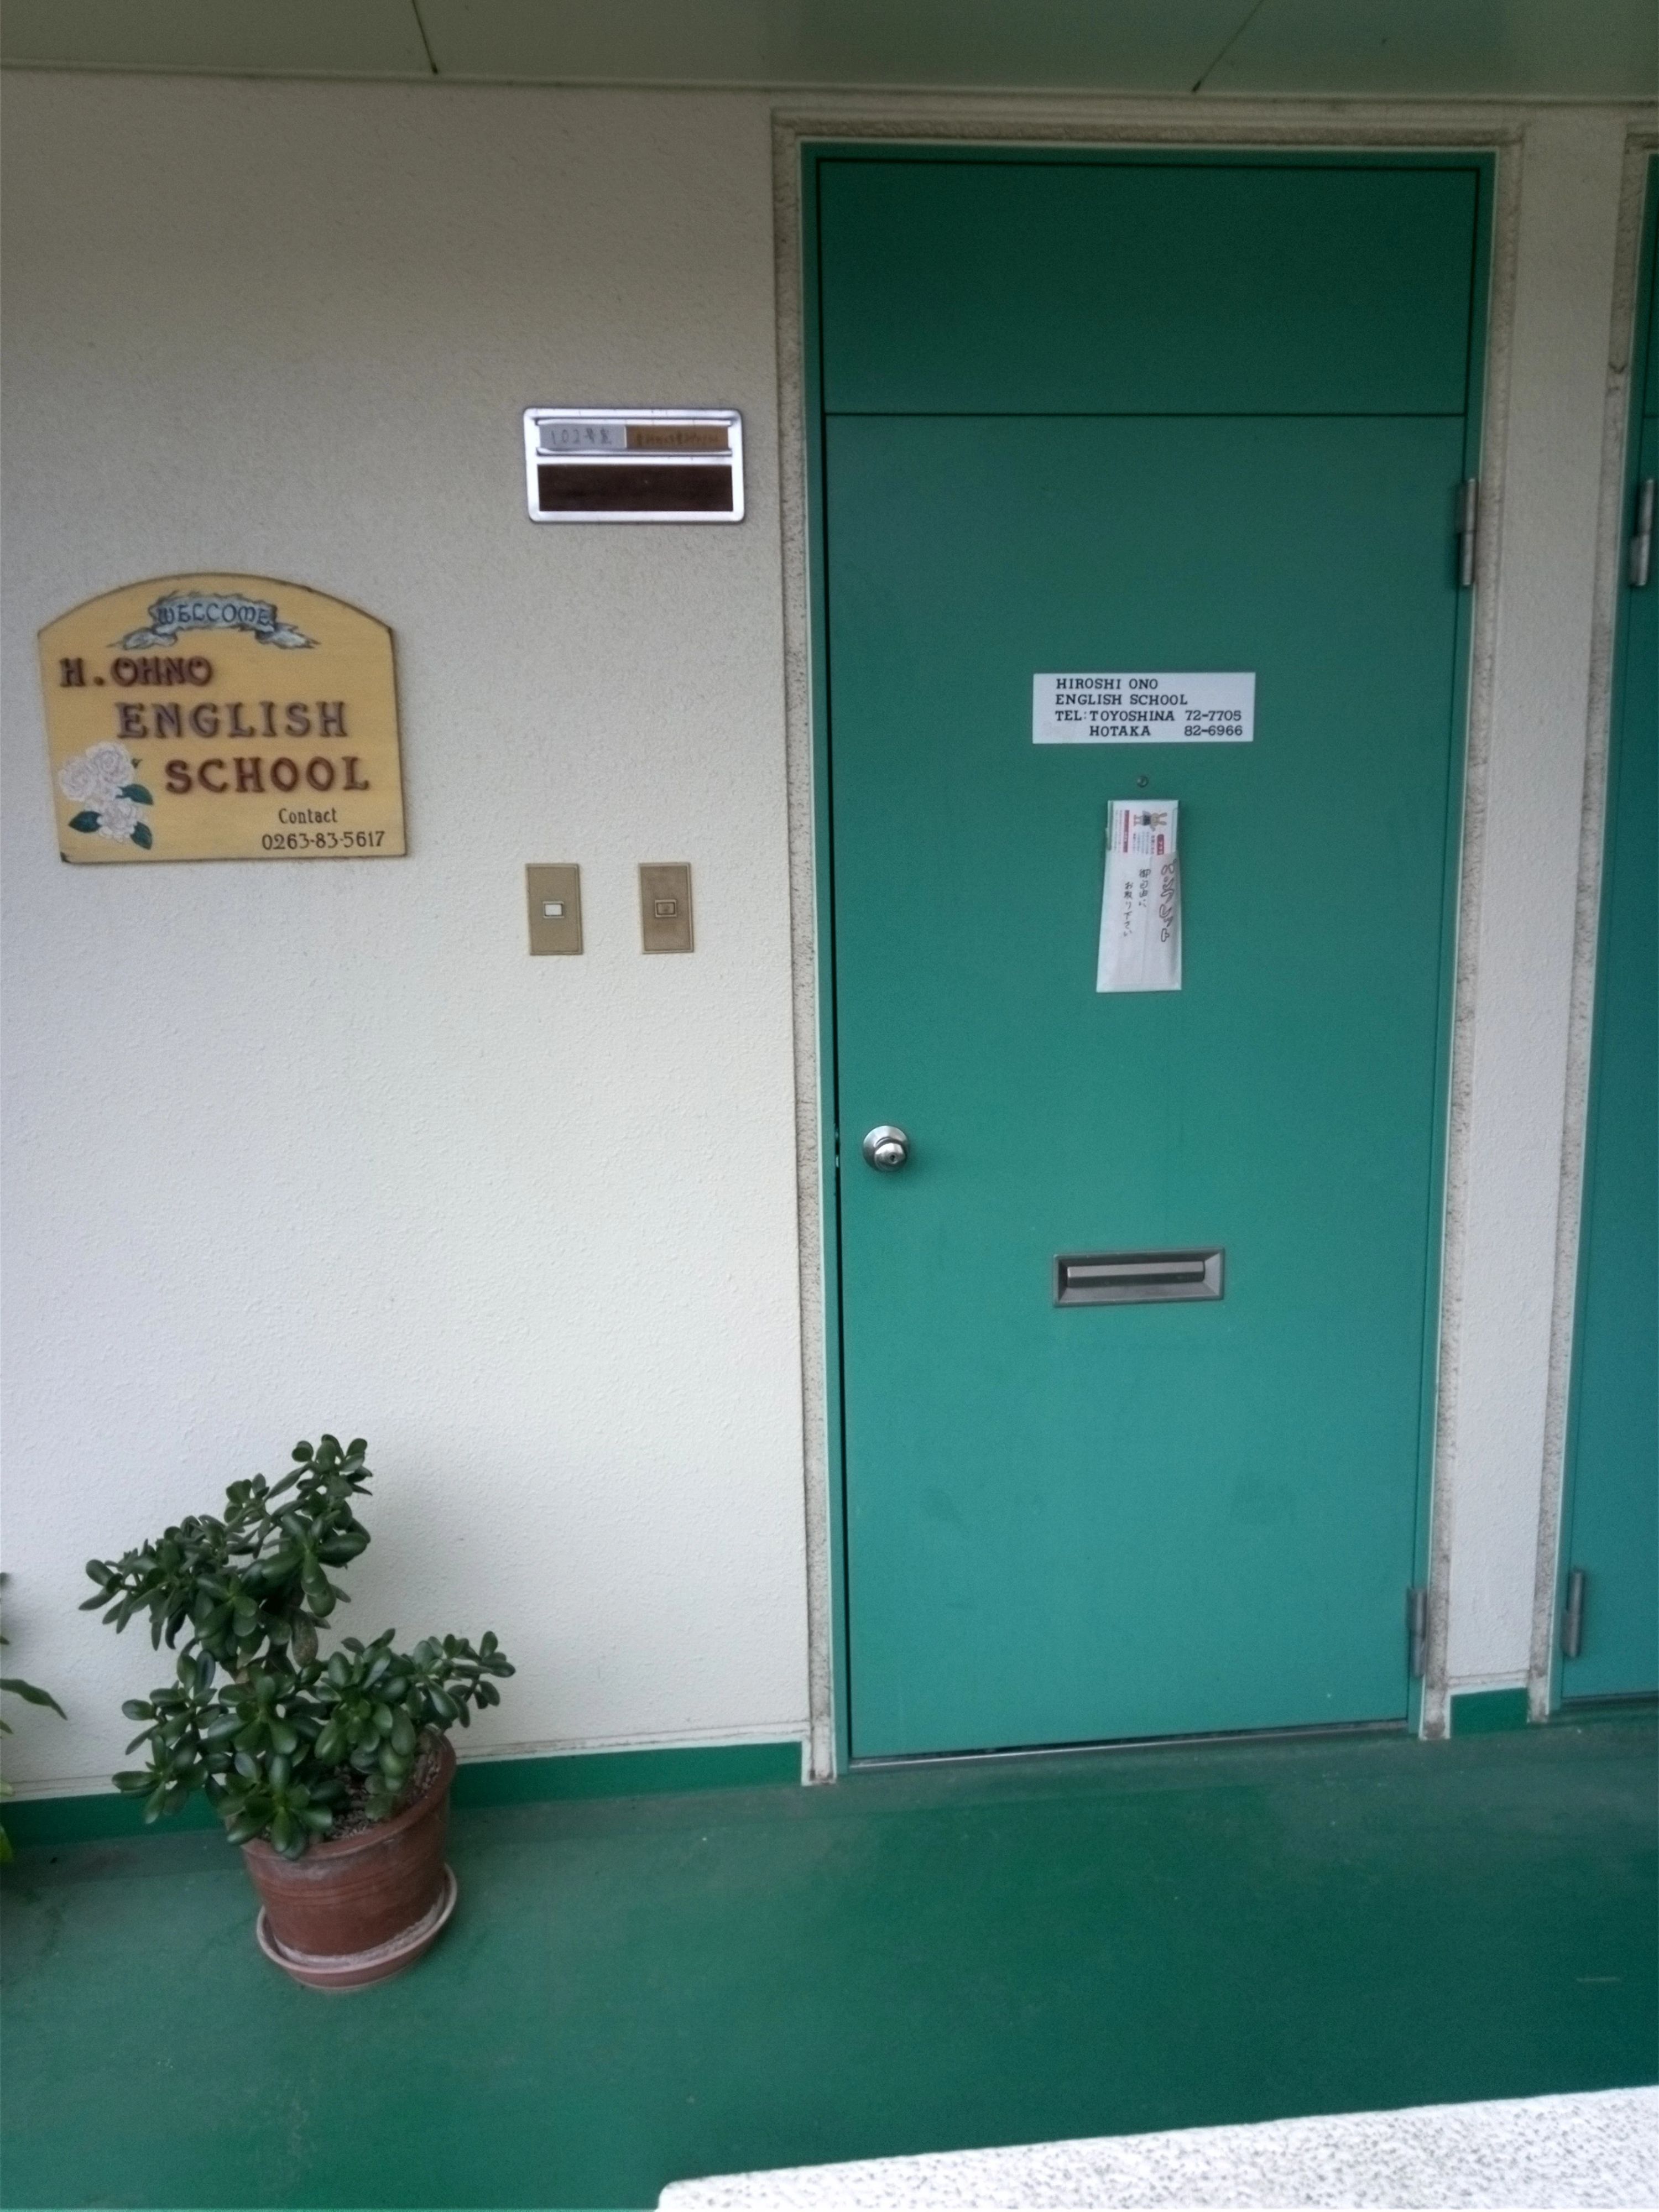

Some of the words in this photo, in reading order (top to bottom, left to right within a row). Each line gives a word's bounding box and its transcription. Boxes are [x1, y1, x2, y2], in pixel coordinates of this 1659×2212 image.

[158, 602, 271, 625] WELCOME
[1056, 678, 1121, 690] HIROSHI
[1129, 678, 1159, 690] ONO
[1055, 694, 1122, 705] ENGLISH
[1130, 694, 1188, 706] SCHOOL
[116, 701, 348, 739] ENGLISH
[1185, 710, 1242, 721] 72-7705
[1089, 726, 1151, 737] HOTAKA
[1184, 725, 1243, 736] 82-6966
[165, 756, 369, 795] SCHOOL
[279, 807, 338, 824] Contact
[262, 831, 385, 851] 0263-83-5617
